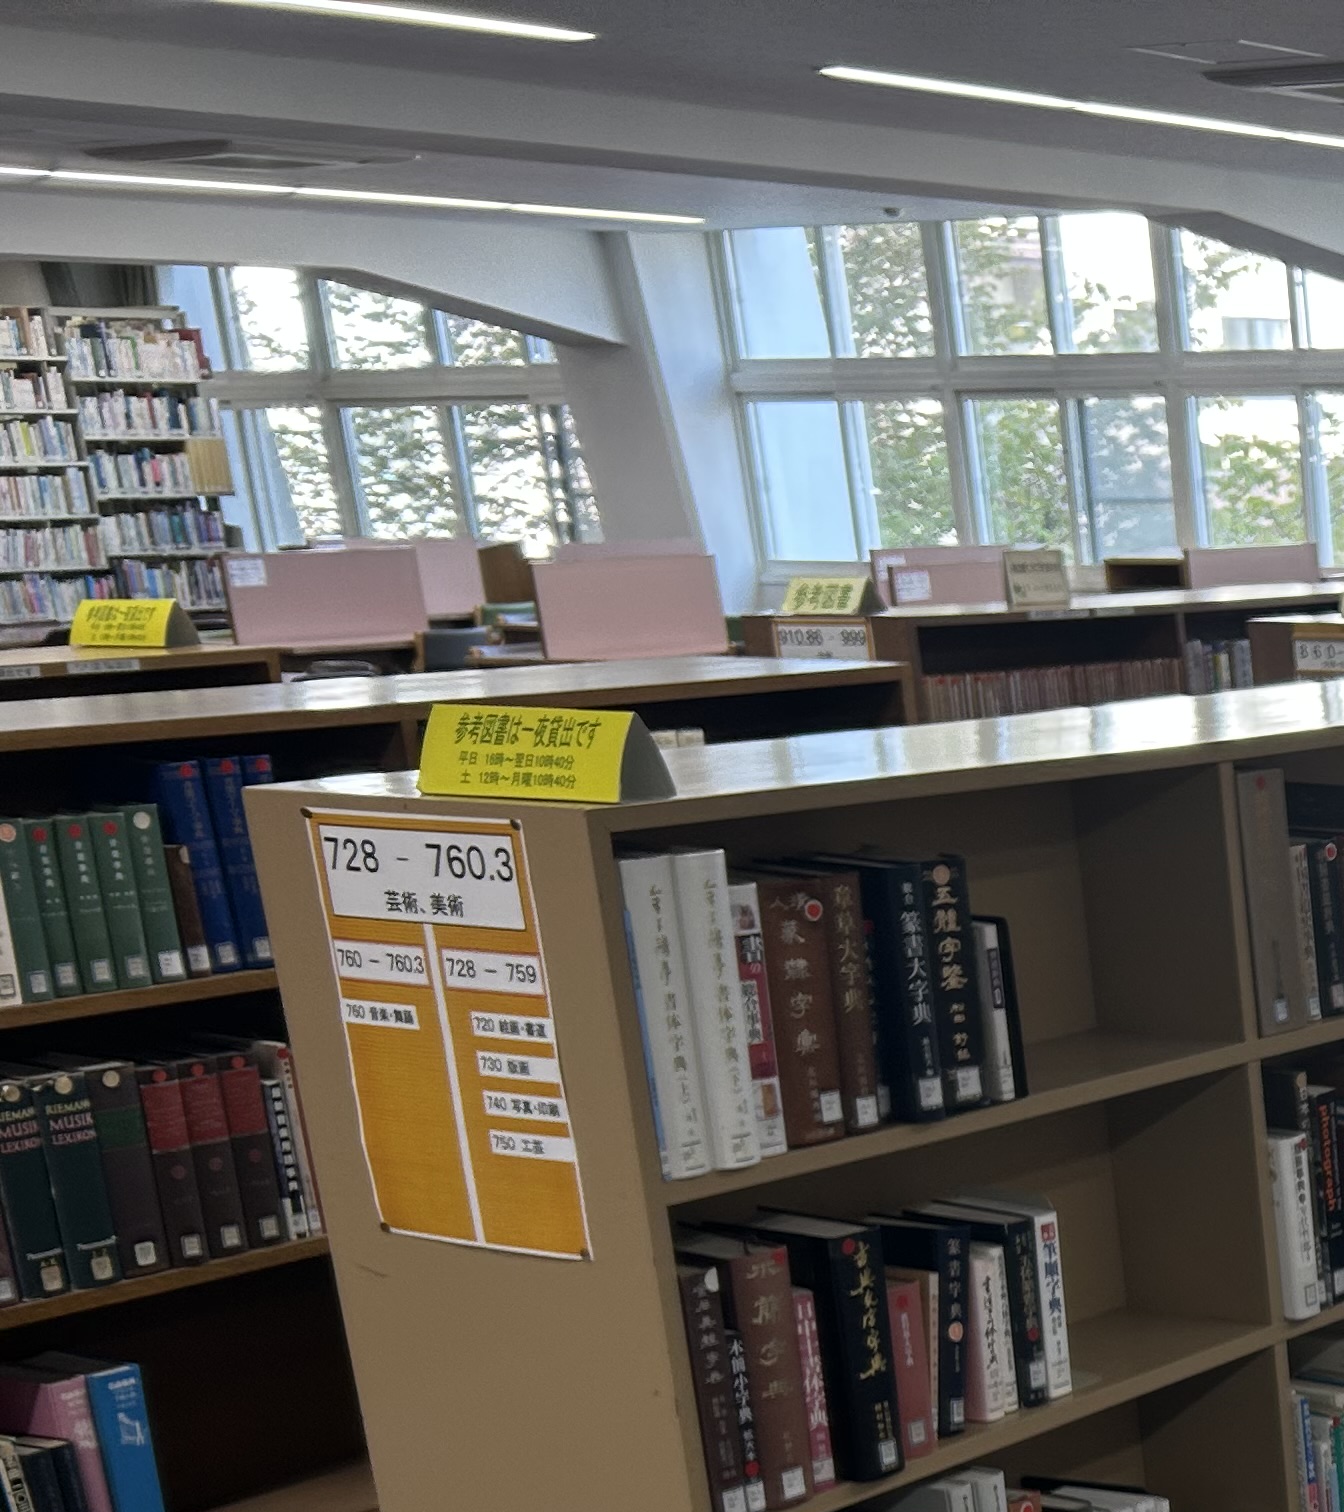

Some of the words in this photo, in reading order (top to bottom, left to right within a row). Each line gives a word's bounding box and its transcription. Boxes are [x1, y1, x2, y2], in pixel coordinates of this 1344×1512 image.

[454, 712, 602, 750] 参考図書は一夜貸出です
[458, 750, 478, 766] 平日
[459, 769, 471, 784] 土
[323, 836, 379, 873] 728
[425, 843, 515, 883] 760.3
[384, 890, 465, 919] 芸術、美術
[337, 948, 362, 970] 760
[386, 953, 425, 975] 760.3
[446, 956, 477, 979] 728
[505, 961, 537, 984] 759
[474, 1016, 495, 1032] 720
[480, 1055, 503, 1073] 730
[487, 1095, 507, 1111] 740
